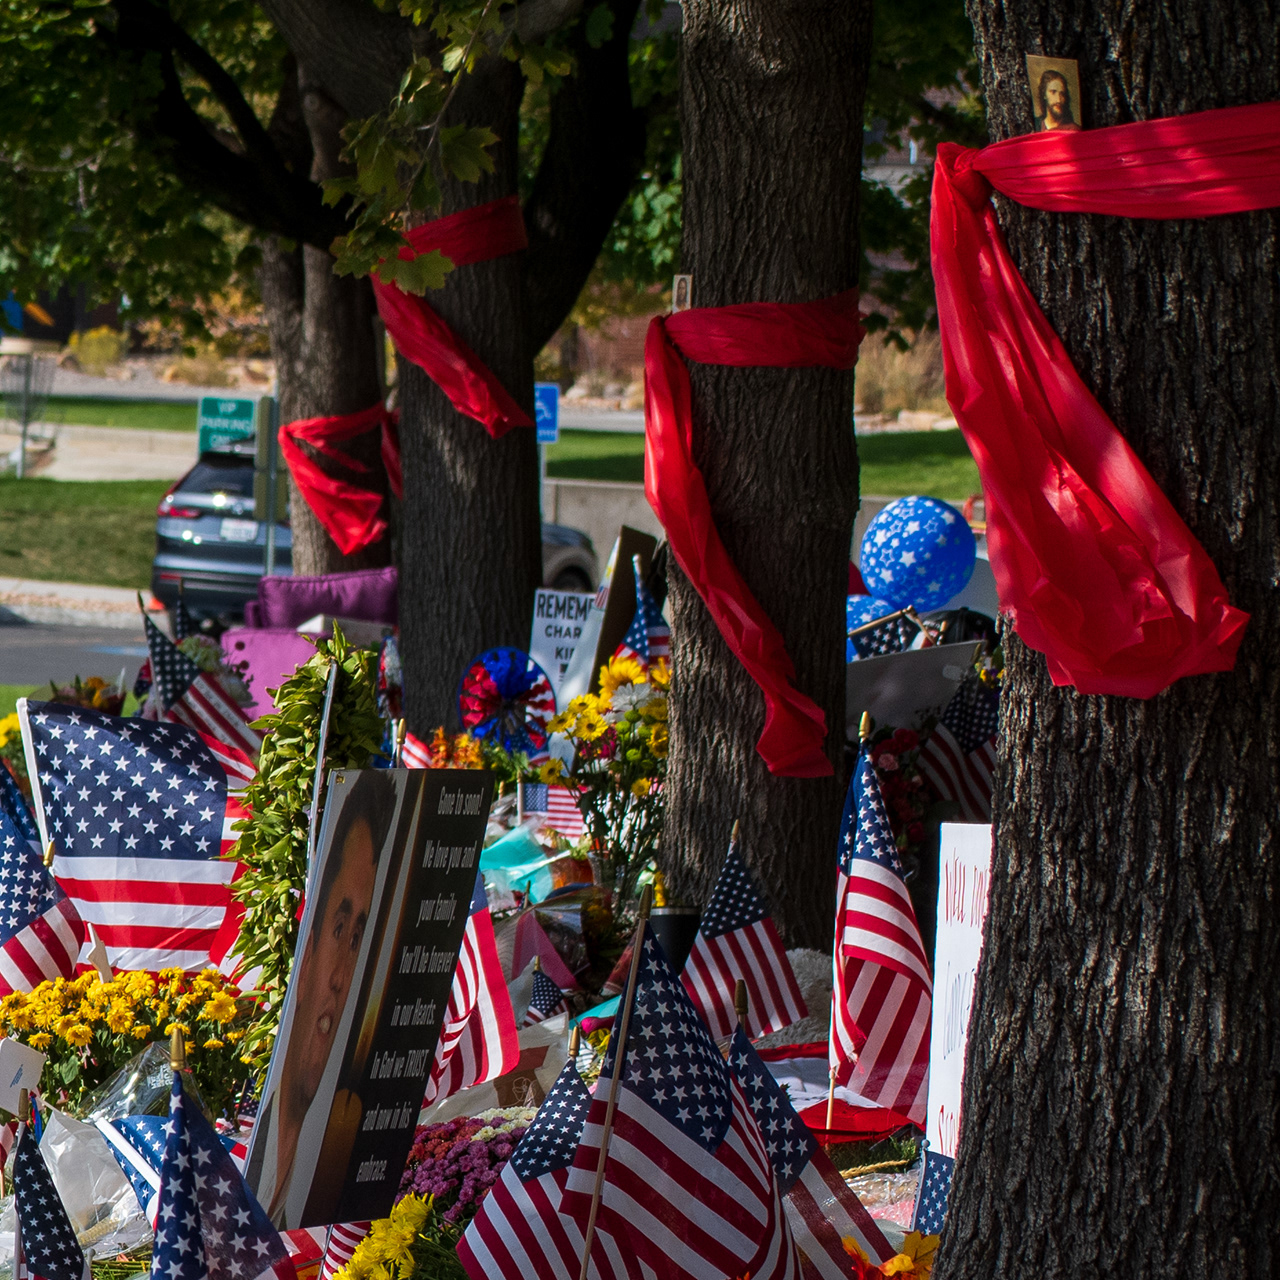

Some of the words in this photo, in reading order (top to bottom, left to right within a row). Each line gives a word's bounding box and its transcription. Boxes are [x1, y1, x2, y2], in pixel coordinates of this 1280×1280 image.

[544, 624, 582, 639] CHAR
[438, 785, 455, 815] Gone
[454, 787, 464, 815] to
[462, 786, 485, 815] soon!
[422, 839, 434, 868] We
[433, 839, 448, 868] love
[445, 846, 462, 876] you
[460, 840, 478, 868] and
[415, 899, 436, 929] your
[433, 892, 458, 928] family.
[417, 945, 428, 973] be
[427, 945, 455, 973] forever
[390, 999, 401, 1026] in
[399, 1004, 414, 1026] our
[413, 997, 436, 1026] Hearts.
[369, 1051, 380, 1079] In
[378, 1050, 394, 1079] God
[392, 1056, 405, 1078] we
[402, 1049, 430, 1081] TRUST,
[362, 1103, 377, 1131] and
[375, 1108, 391, 1130] now
[389, 1102, 400, 1129] in
[398, 1101, 413, 1129] his
[355, 1154, 388, 1182] embrace.
